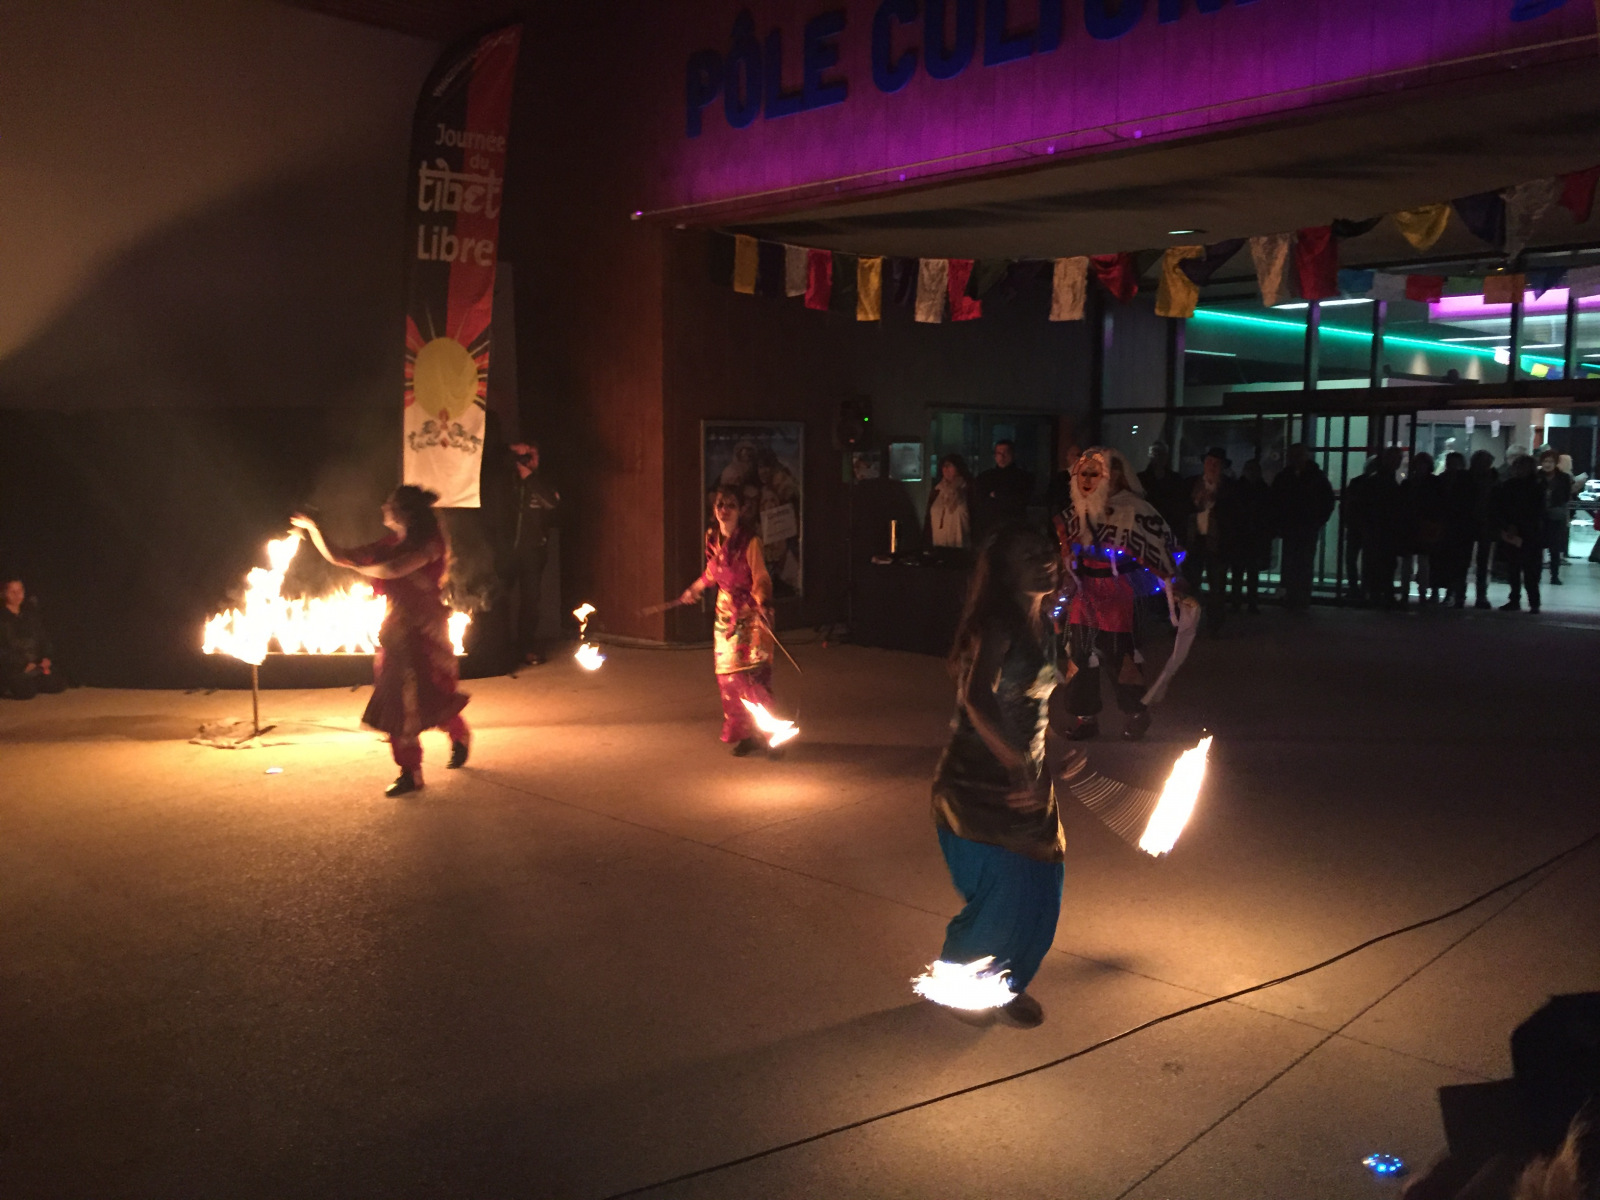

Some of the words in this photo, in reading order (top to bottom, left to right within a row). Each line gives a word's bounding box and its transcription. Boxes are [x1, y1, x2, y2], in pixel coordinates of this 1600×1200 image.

[685, 8, 847, 138] PÔLE
[871, 0, 1259, 93] CULT
[434, 123, 506, 152] Journée
[469, 152, 490, 170] du
[416, 224, 495, 267] Libre
